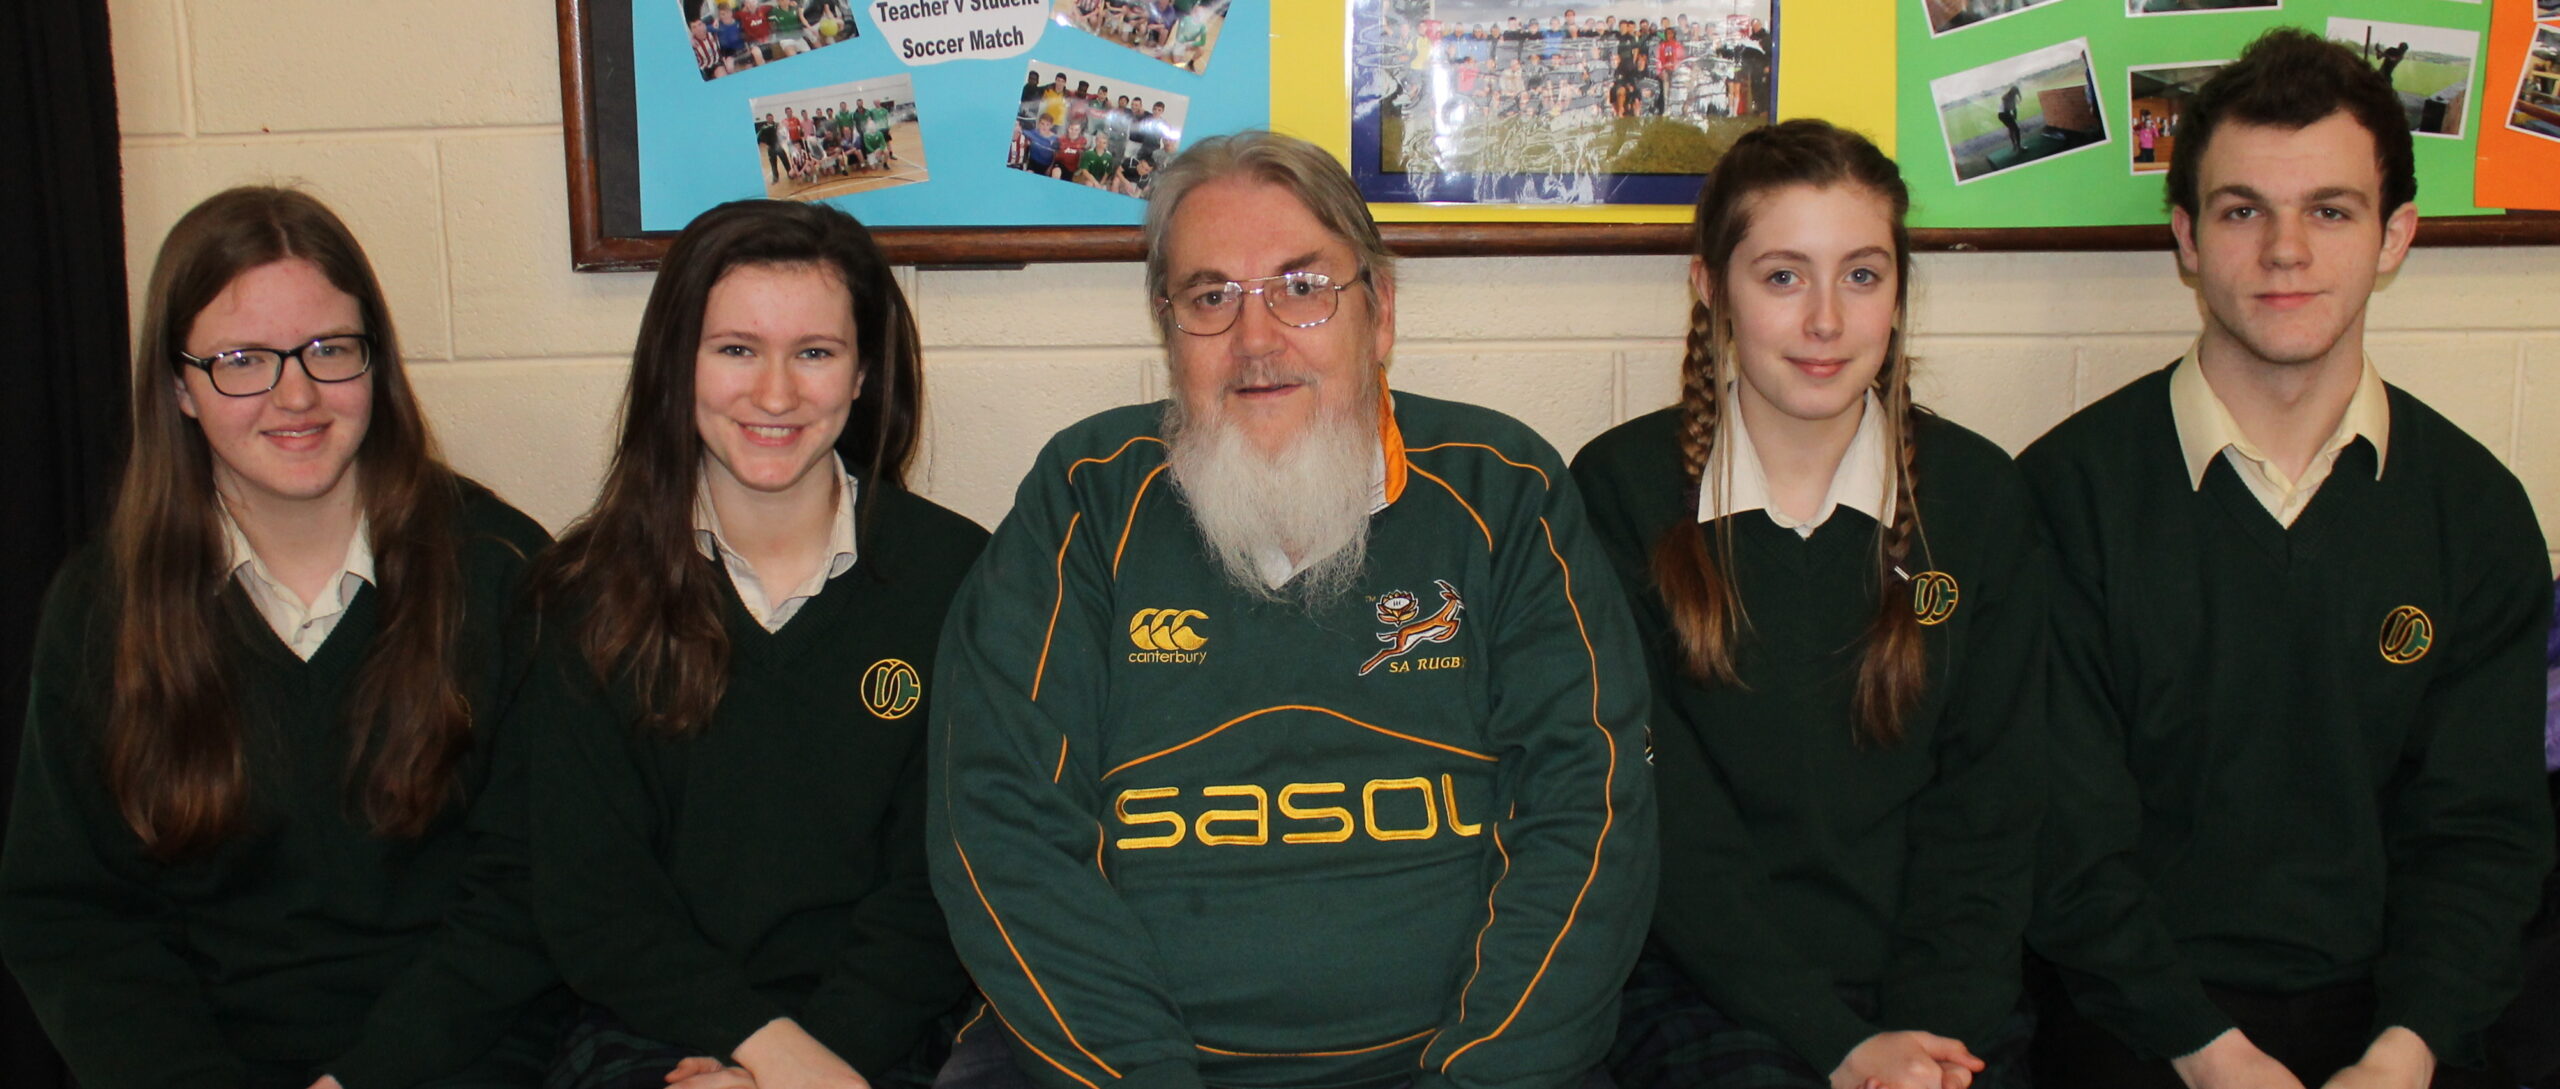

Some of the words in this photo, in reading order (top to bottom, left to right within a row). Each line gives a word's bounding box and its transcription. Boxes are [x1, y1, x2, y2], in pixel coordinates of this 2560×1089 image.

[876, 0, 949, 22] Teacher
[902, 38, 965, 59] Soccer
[969, 25, 1024, 51] Match
[1128, 650, 1207, 665] canterbury
[1389, 661, 1411, 673] SA
